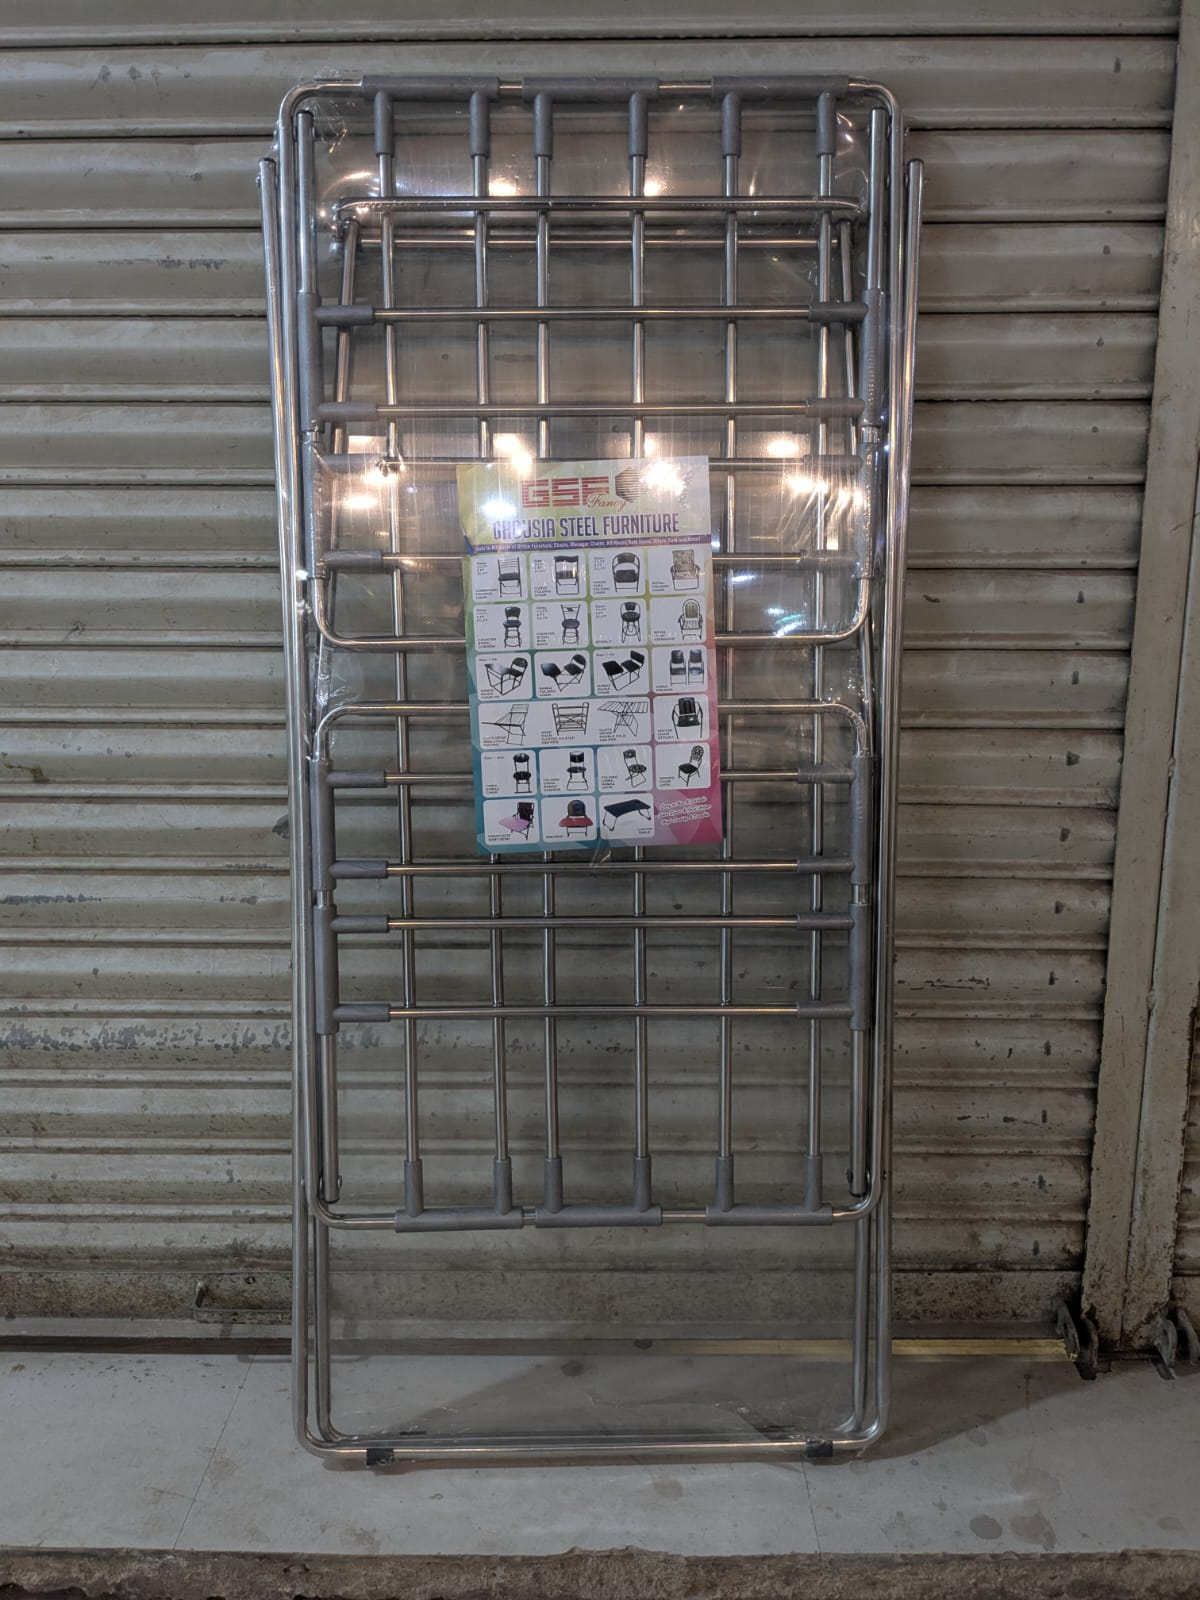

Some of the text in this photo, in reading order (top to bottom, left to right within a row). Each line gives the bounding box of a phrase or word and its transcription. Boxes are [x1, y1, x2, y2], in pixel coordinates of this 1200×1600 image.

[587, 492, 626, 513] Fancy
[493, 512, 680, 540] GHOUSIA STEEL FURNITURE
